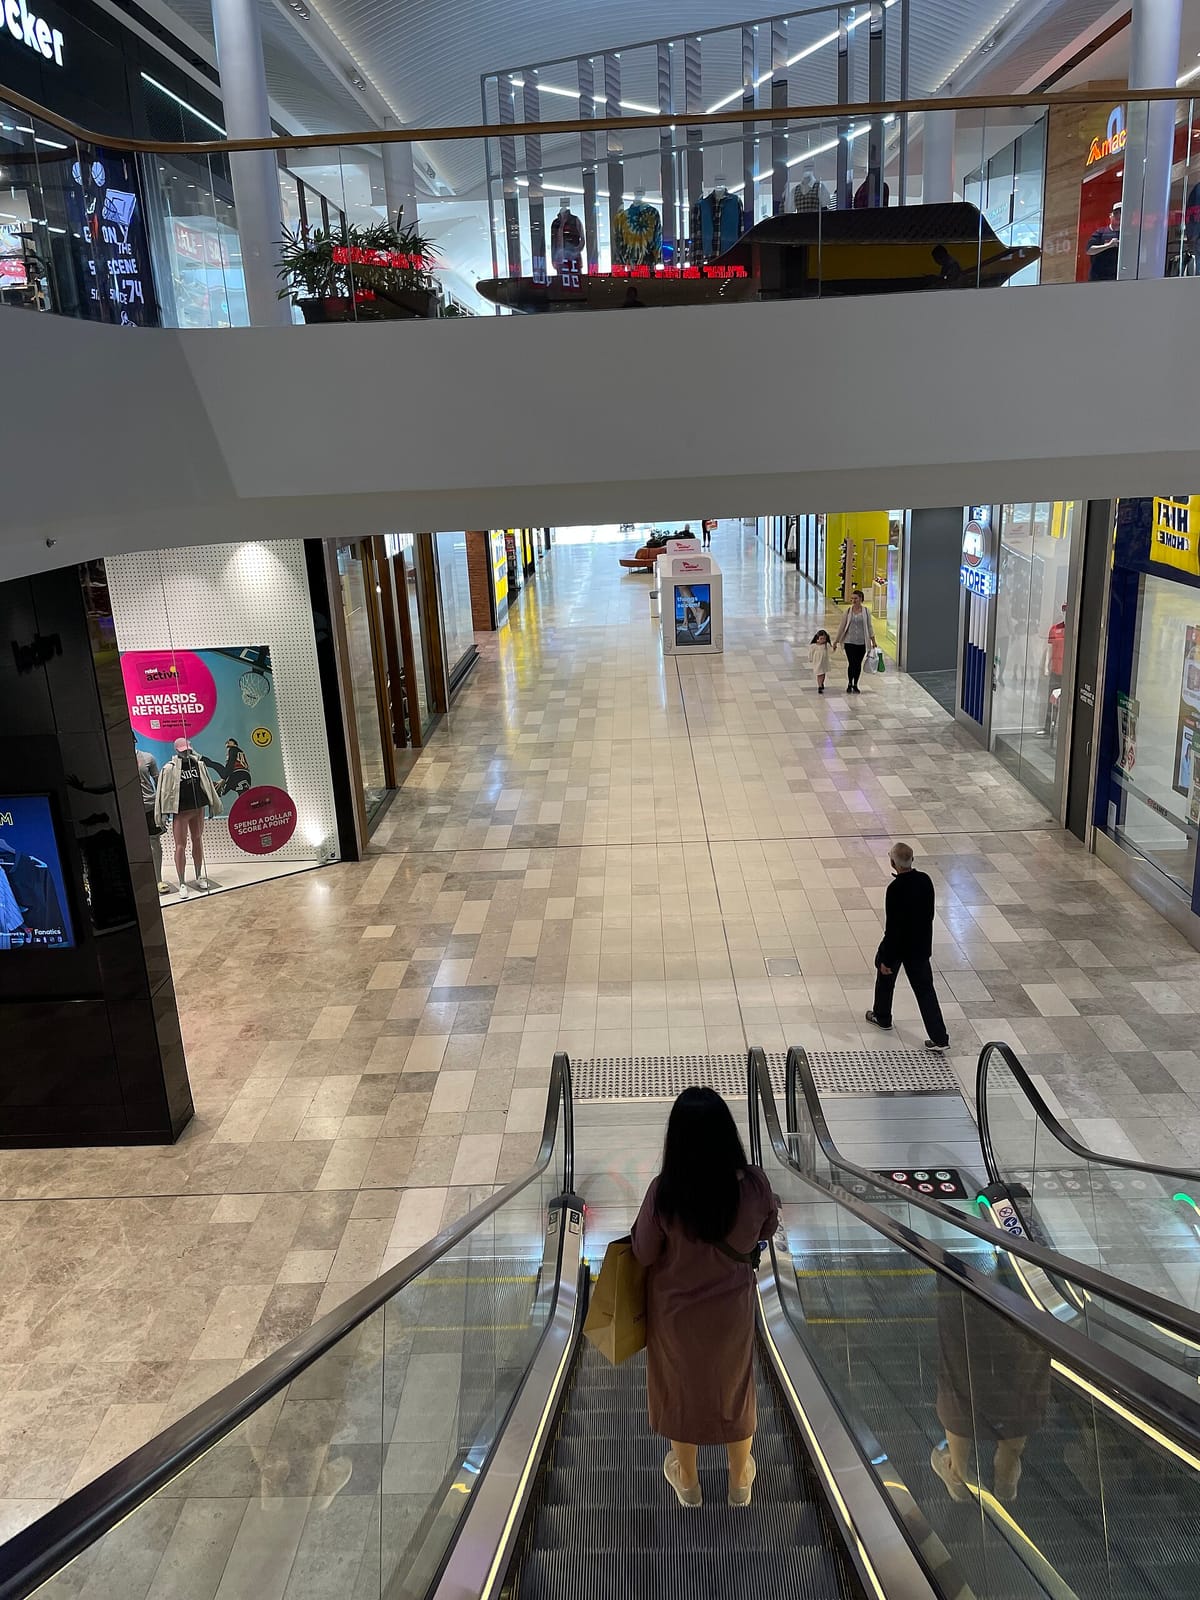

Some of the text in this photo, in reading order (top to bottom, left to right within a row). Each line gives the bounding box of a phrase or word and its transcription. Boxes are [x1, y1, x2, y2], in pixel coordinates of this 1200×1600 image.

[117, 243, 132, 256] THE
[108, 258, 138, 276] SCENE
[960, 565, 986, 594] STORE
[146, 670, 180, 682] active
[135, 693, 197, 705] REWARDS
[132, 704, 204, 716] REFRESHED
[234, 819, 257, 830] SPEND
[264, 811, 292, 822] DOLLAR
[238, 824, 262, 835] SCORE
[269, 818, 290, 828] POINT
